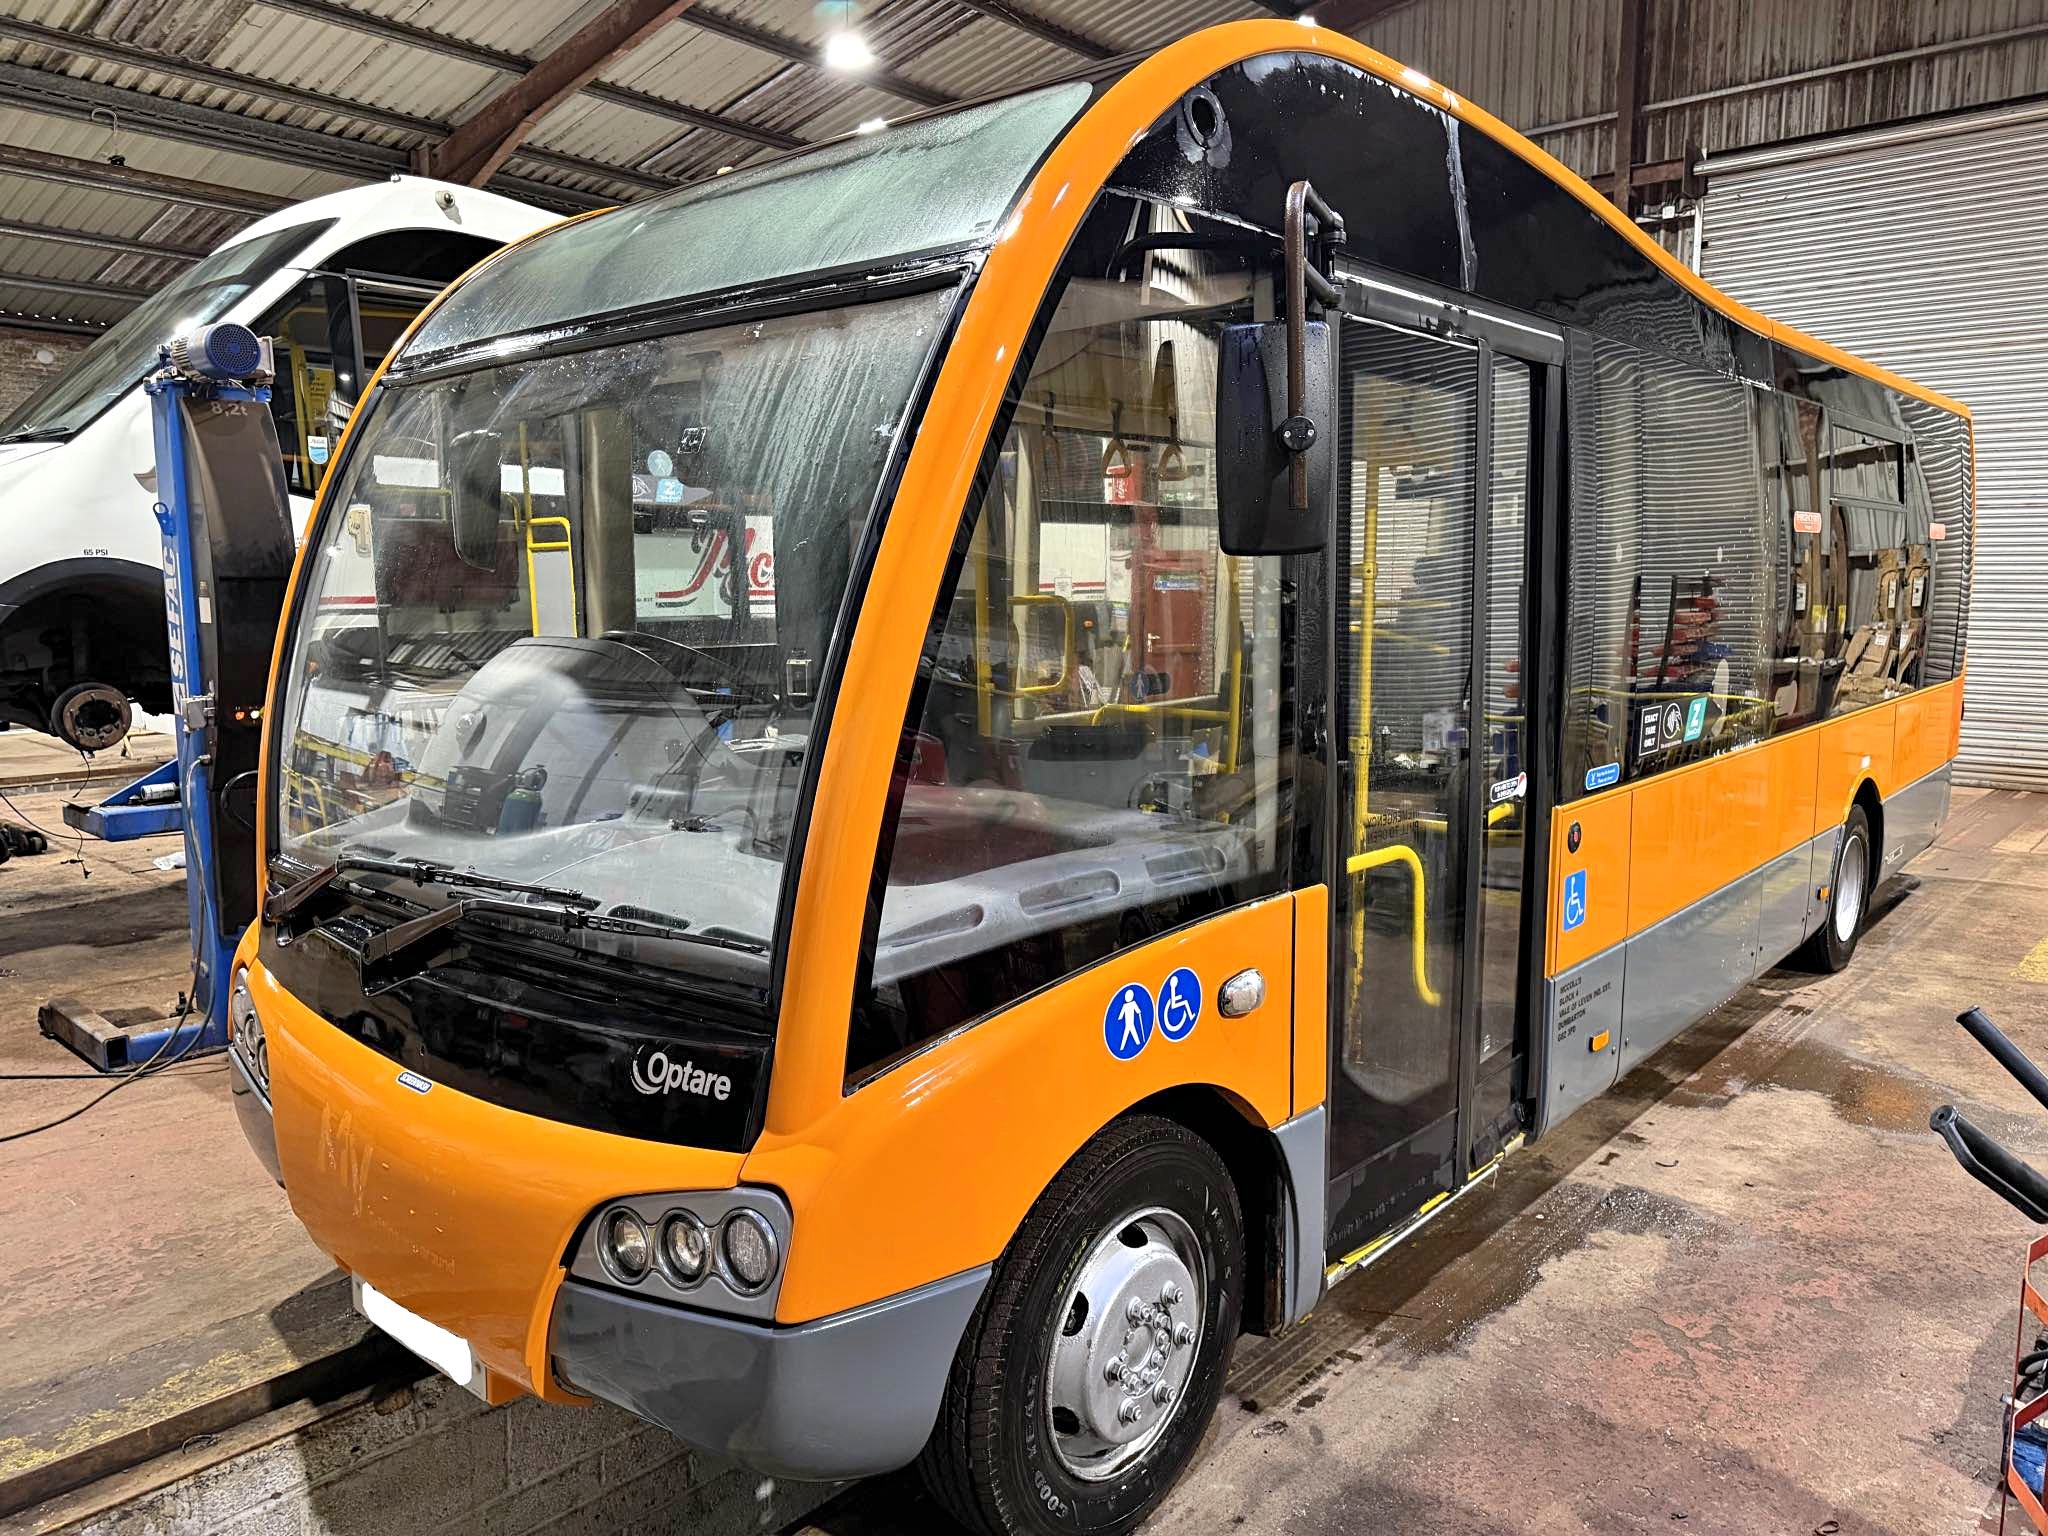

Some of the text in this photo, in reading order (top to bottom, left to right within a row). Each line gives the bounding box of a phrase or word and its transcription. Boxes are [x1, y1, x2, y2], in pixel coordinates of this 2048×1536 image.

[163, 545, 185, 681] SEFAC
[1644, 712, 1659, 724] EXACT
[1645, 725, 1657, 736] FARE
[1643, 737, 1656, 748] ONLY
[1560, 992, 1574, 1006] BLOCK
[1571, 1001, 1577, 1011] OF
[647, 1051, 731, 1101] Optare
